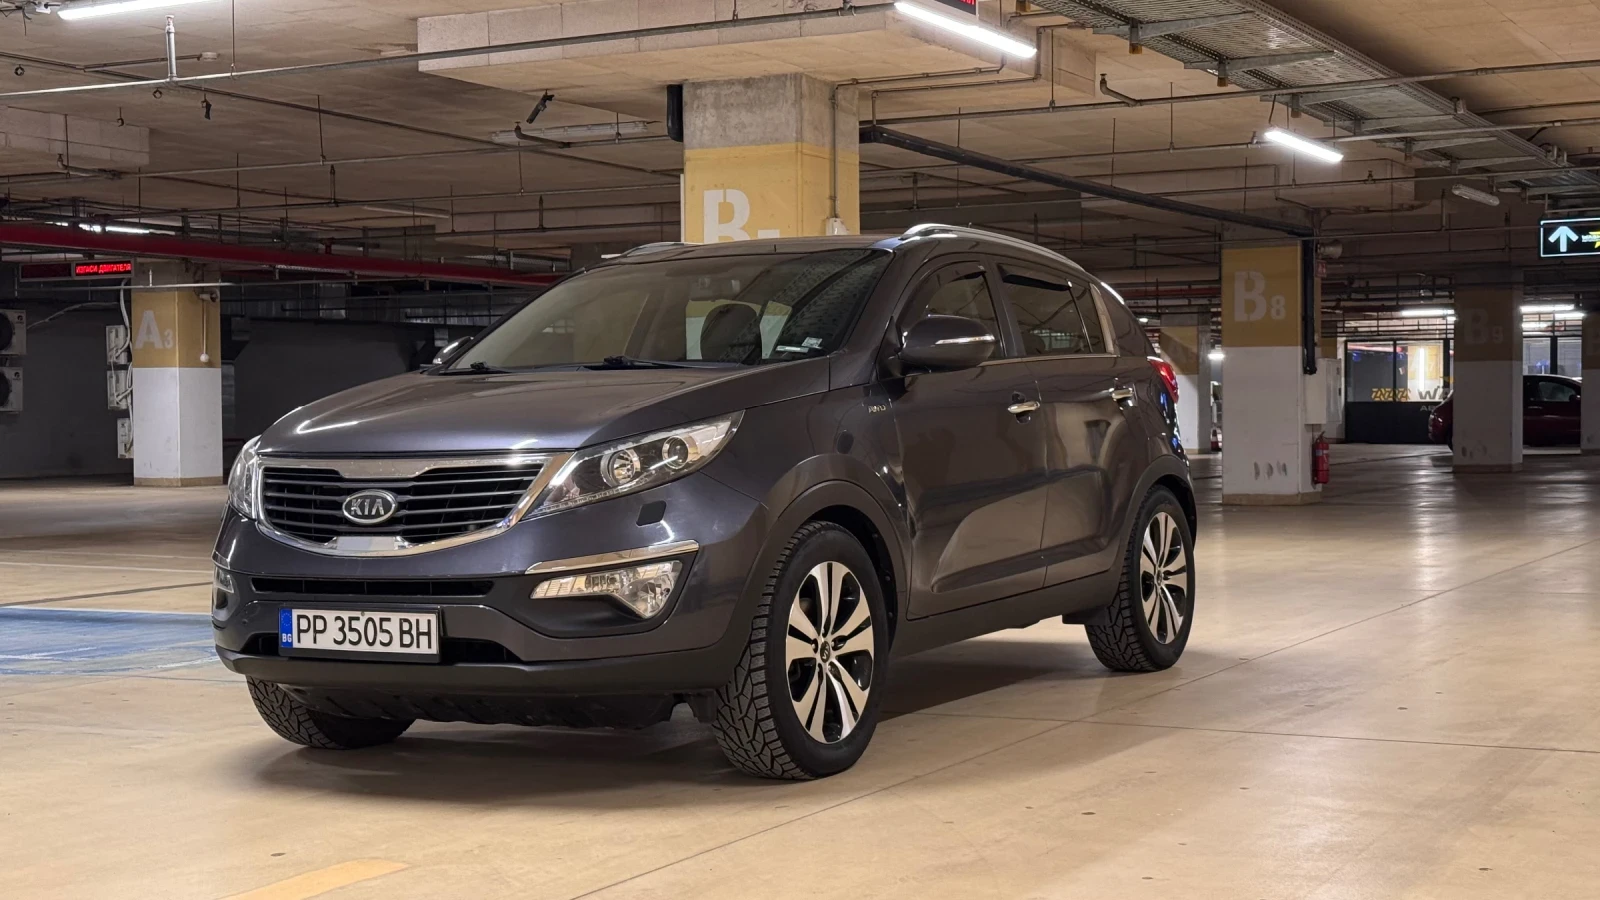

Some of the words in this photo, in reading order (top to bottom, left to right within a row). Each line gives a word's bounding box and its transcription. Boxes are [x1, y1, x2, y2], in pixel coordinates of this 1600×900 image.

[1234, 271, 1286, 321] B8
[135, 310, 173, 349] A3
[351, 498, 385, 516] KIA
[282, 633, 293, 643] BG
[297, 614, 327, 645] PP
[333, 615, 394, 647] 3505
[399, 617, 432, 649] BH
